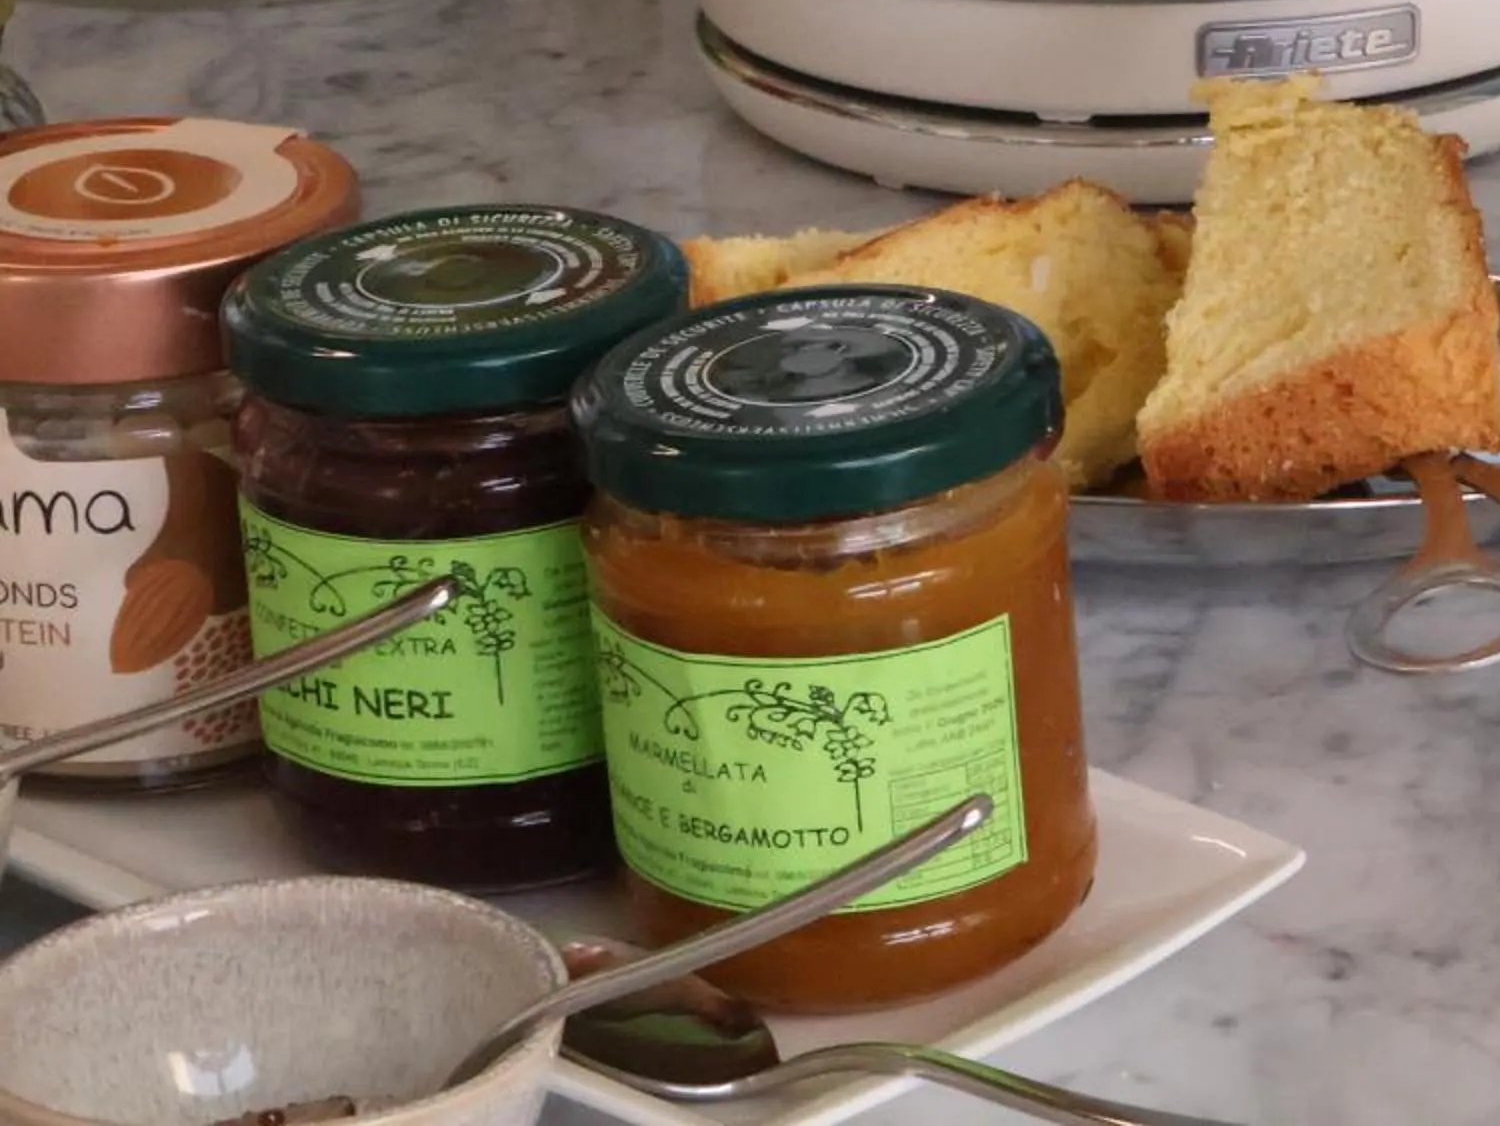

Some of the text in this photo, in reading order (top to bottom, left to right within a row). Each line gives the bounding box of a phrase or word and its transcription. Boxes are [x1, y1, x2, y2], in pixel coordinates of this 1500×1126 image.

[1211, 28, 1408, 70] Ariete
[353, 685, 454, 719] NERI
[629, 732, 768, 783] MARMELLATA
[679, 812, 850, 850] BERGAMOTTO
